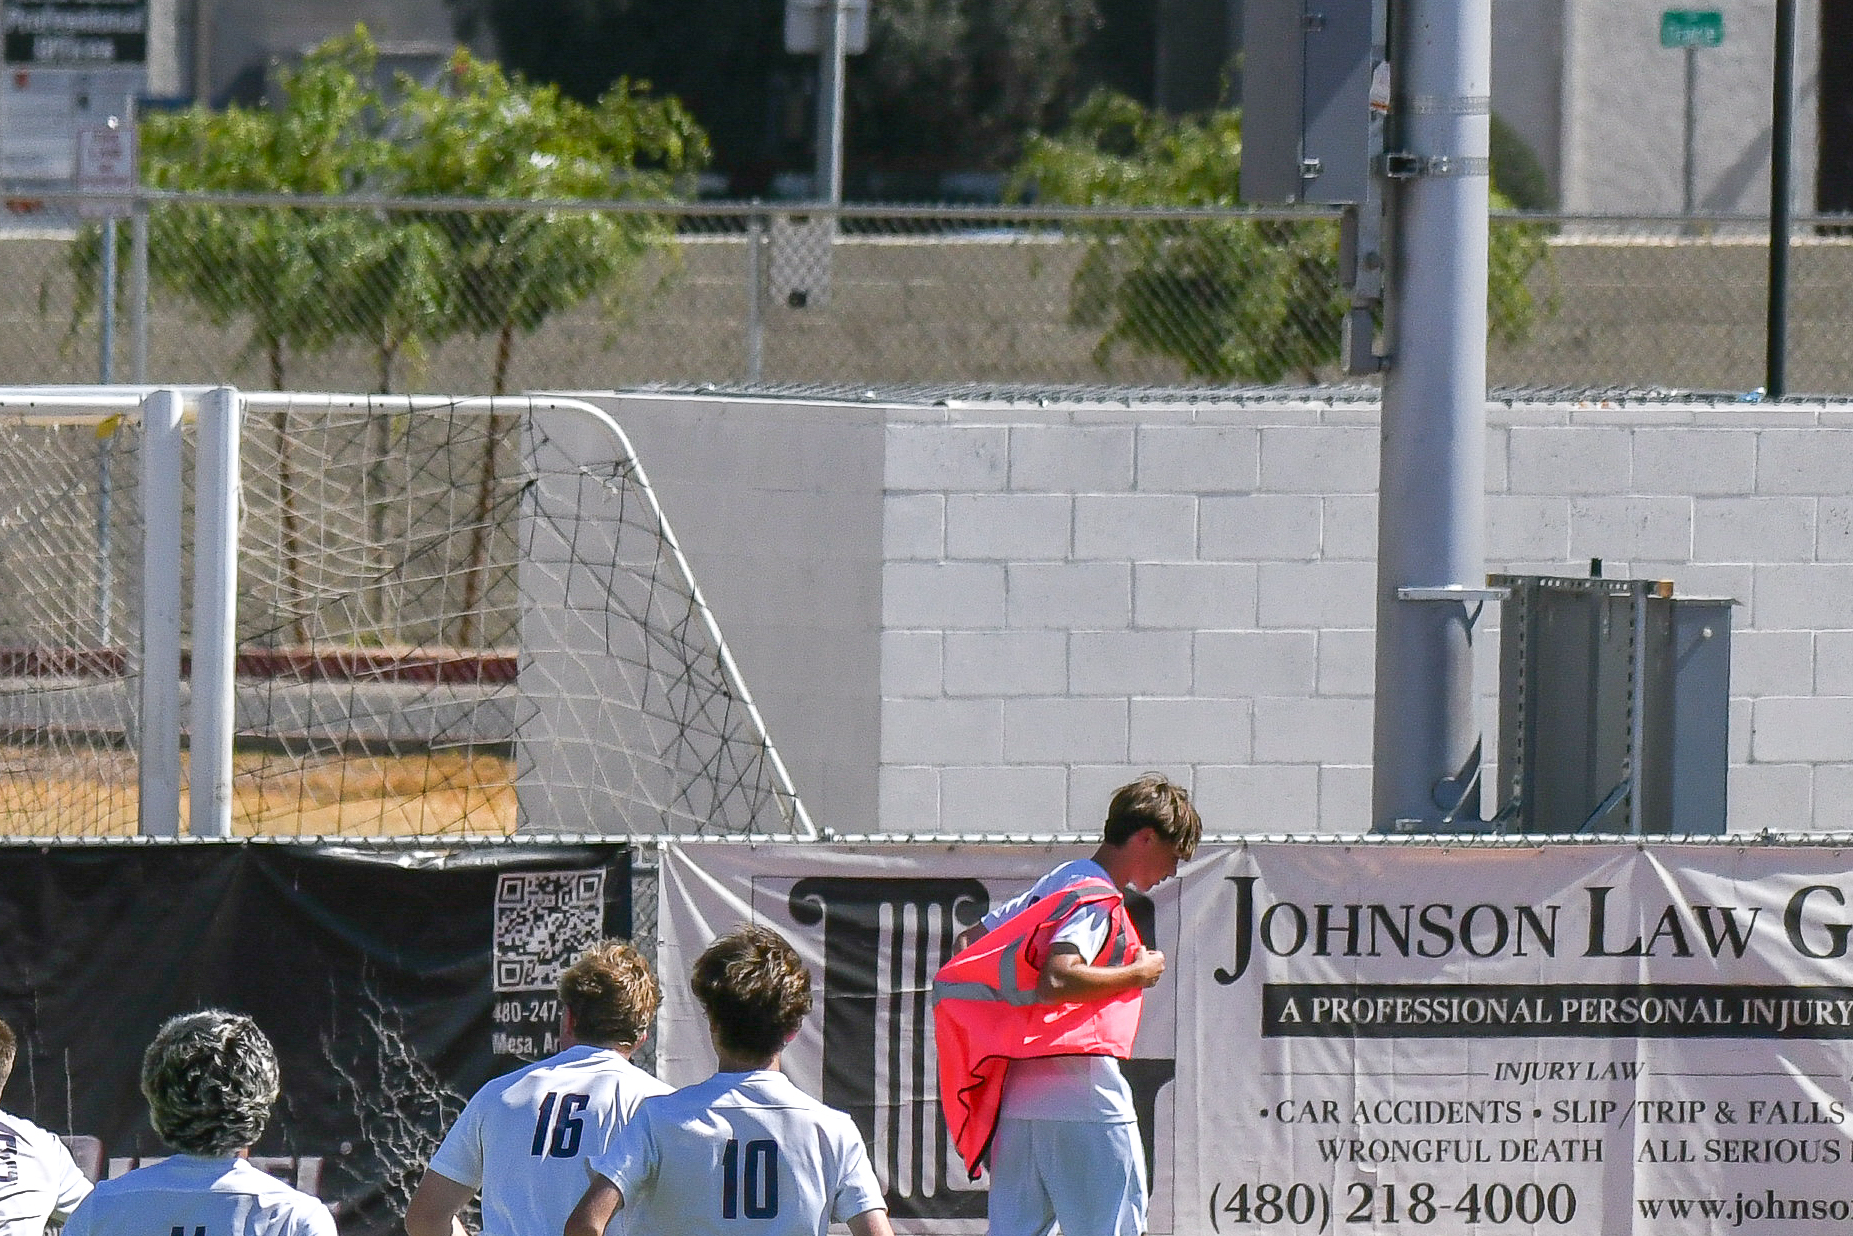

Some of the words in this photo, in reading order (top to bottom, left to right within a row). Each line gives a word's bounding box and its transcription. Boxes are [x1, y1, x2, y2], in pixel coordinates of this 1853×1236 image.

[1213, 876, 1562, 985] JOHNSON
[1581, 886, 1762, 960] LAW
[1784, 884, 1853, 960] G
[1278, 996, 1302, 1025] A
[1311, 997, 1552, 1026] PROFESSIONAL
[1560, 997, 1732, 1025] PERSONAL
[492, 1031, 538, 1056] Mesa,
[1494, 1061, 1581, 1086] INJURY
[1585, 1062, 1645, 1081] LAW
[530, 1091, 590, 1159] 16
[1275, 1100, 1341, 1124] CAR
[1350, 1100, 1523, 1124] ACCIDENTS
[1714, 1101, 1740, 1124] &
[1747, 1100, 1846, 1125] FALLS
[1317, 1138, 1492, 1164] WRONGFUL
[1499, 1138, 1603, 1164] DEATH
[1637, 1138, 1696, 1164] ALL
[1703, 1138, 1841, 1165] SERIOUS
[722, 1138, 779, 1219] 10
[1209, 1182, 1331, 1235] (480)
[1344, 1181, 1577, 1226] 218-4000
[1637, 1190, 1853, 1227] www.johnso
